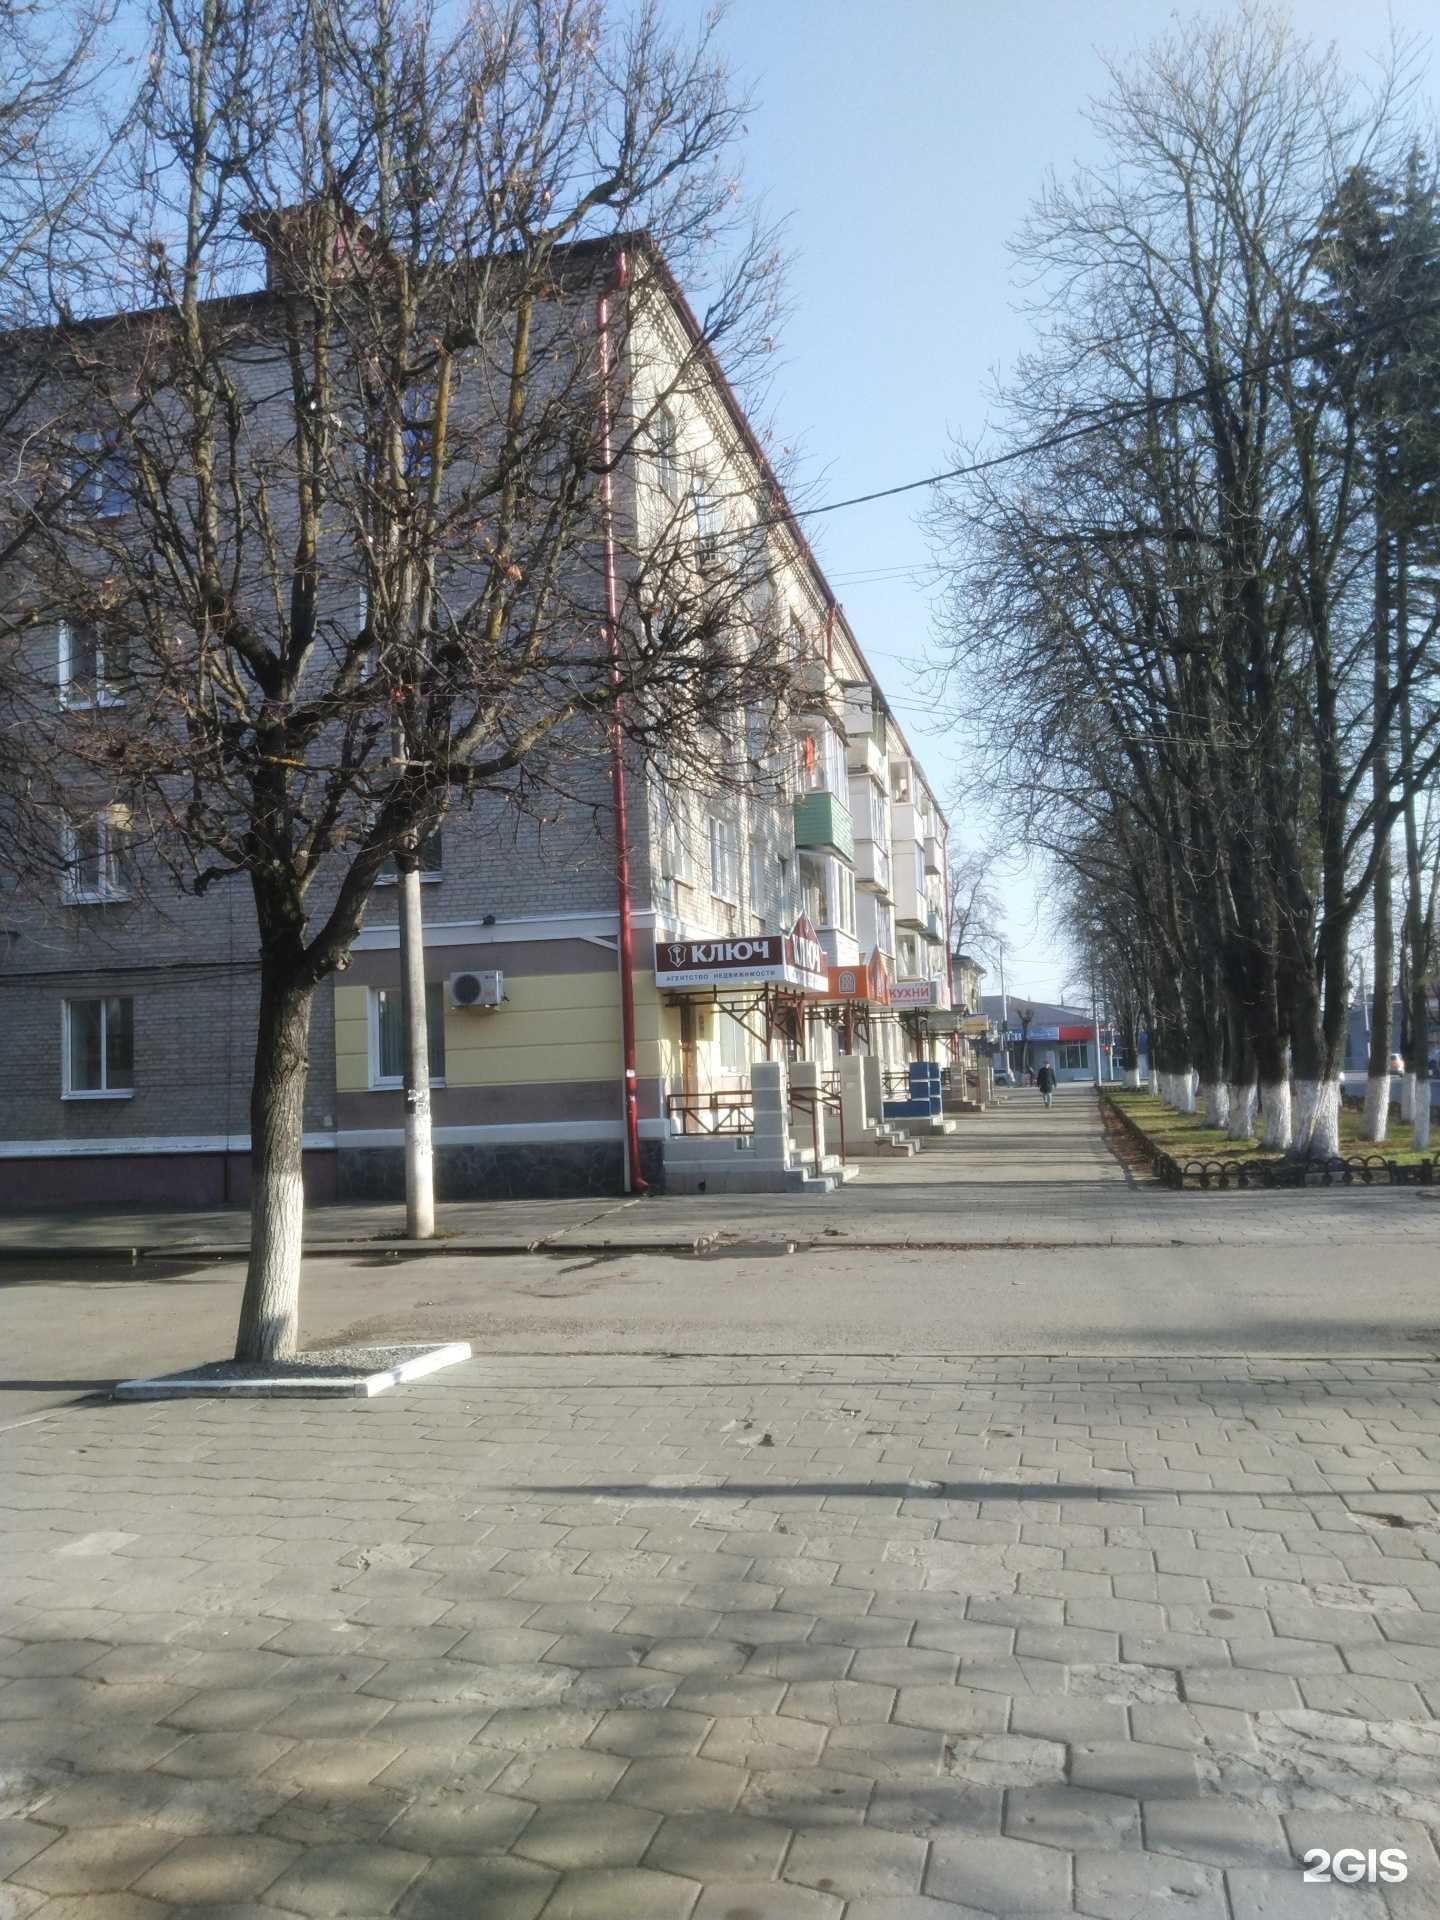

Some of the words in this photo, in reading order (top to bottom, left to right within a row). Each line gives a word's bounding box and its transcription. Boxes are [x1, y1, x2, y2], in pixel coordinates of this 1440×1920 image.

[691, 941, 769, 963] КЛЮЧ
[666, 973, 709, 982] АГЕНТСТВО
[889, 987, 928, 998] КУХНИ
